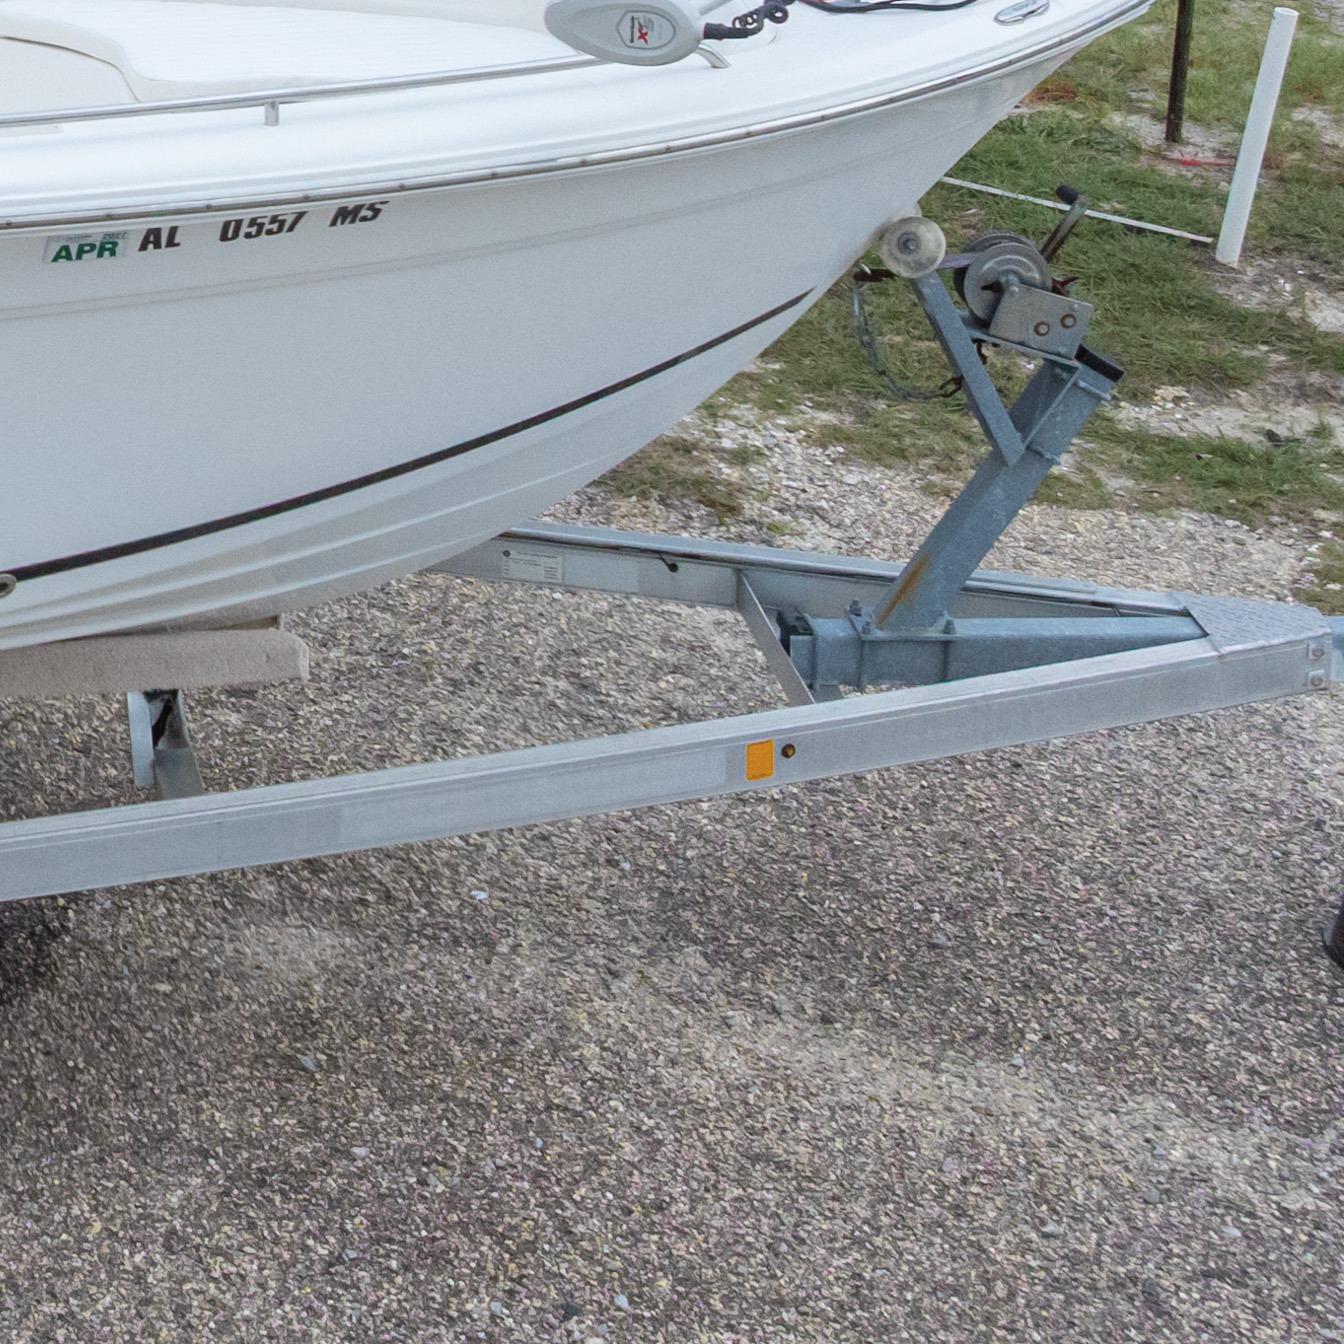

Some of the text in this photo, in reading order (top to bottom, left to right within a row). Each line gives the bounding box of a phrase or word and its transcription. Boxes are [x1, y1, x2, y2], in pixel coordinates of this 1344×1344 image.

[138, 200, 390, 252] AL 0557 MS
[51, 240, 119, 263] APR
